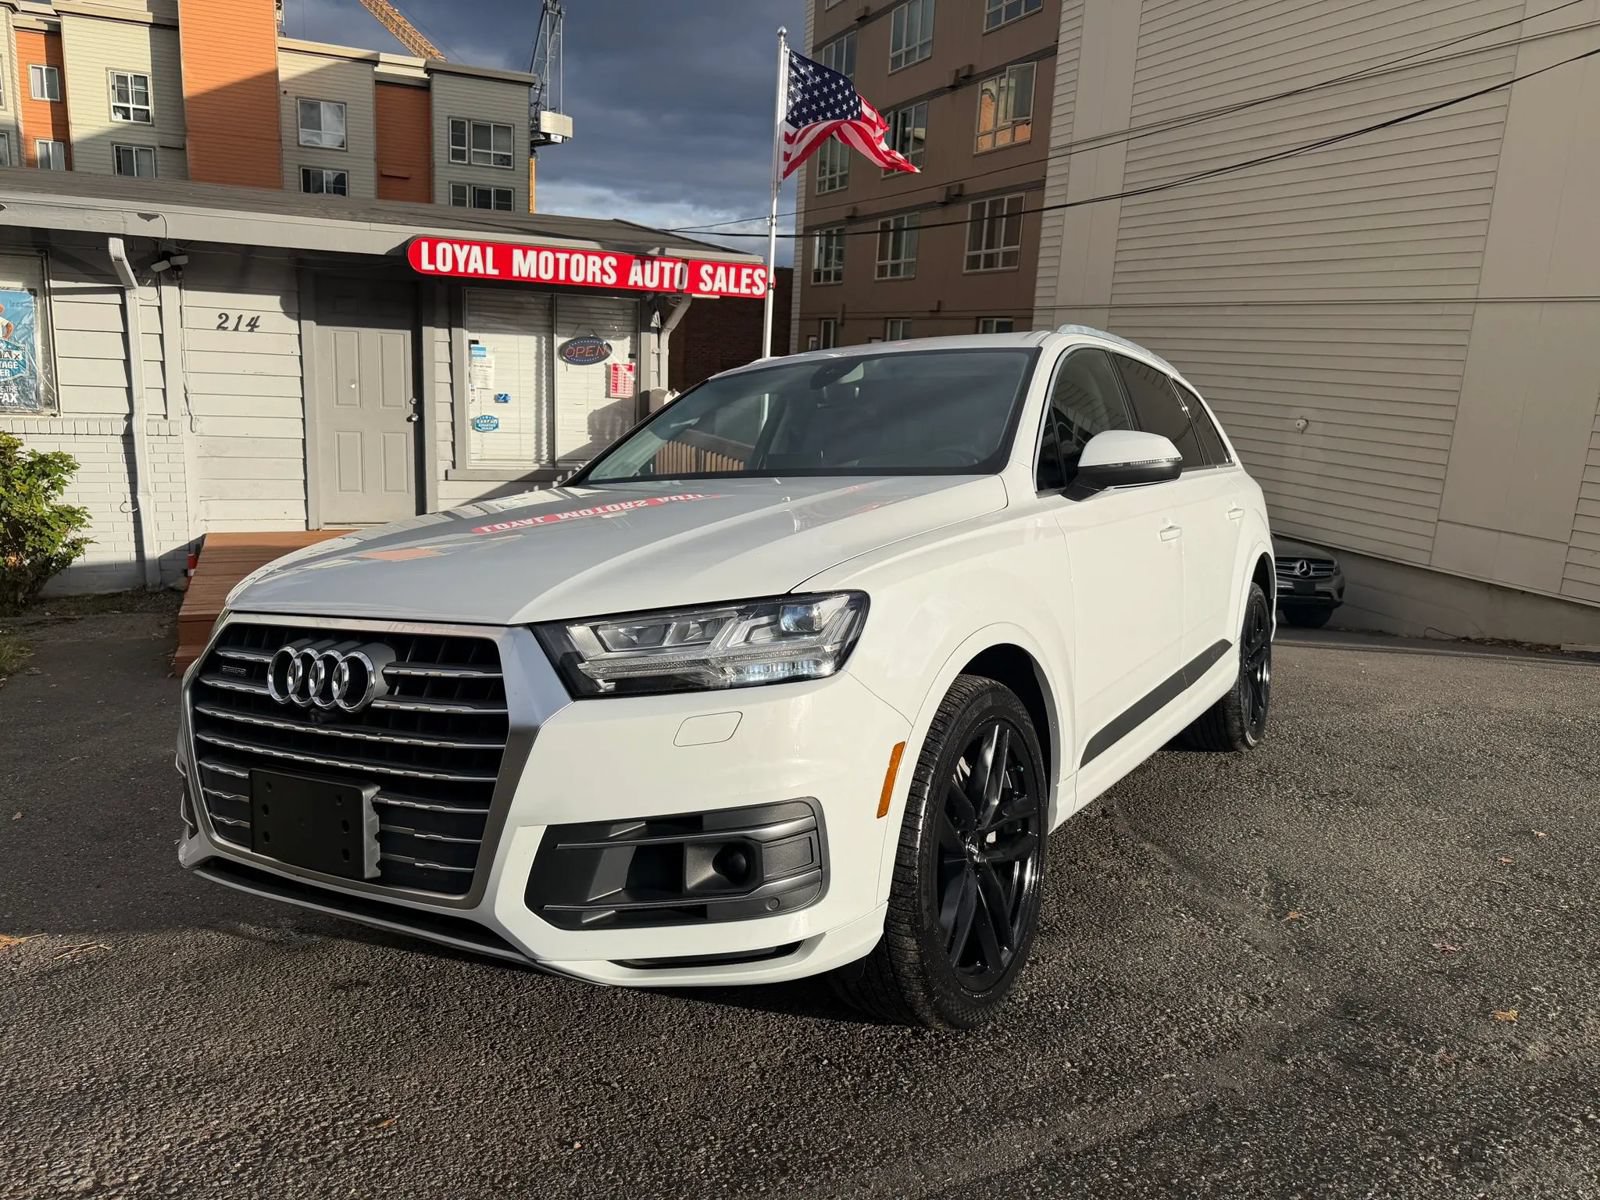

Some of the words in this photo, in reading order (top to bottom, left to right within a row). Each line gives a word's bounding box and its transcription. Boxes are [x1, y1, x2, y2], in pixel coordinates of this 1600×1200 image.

[421, 241, 499, 275] LOYAL
[512, 249, 617, 286] MOTORS
[628, 259, 688, 290] AUTO
[699, 264, 766, 296] SALES
[216, 313, 261, 332] 214
[565, 345, 607, 358] OPEN
